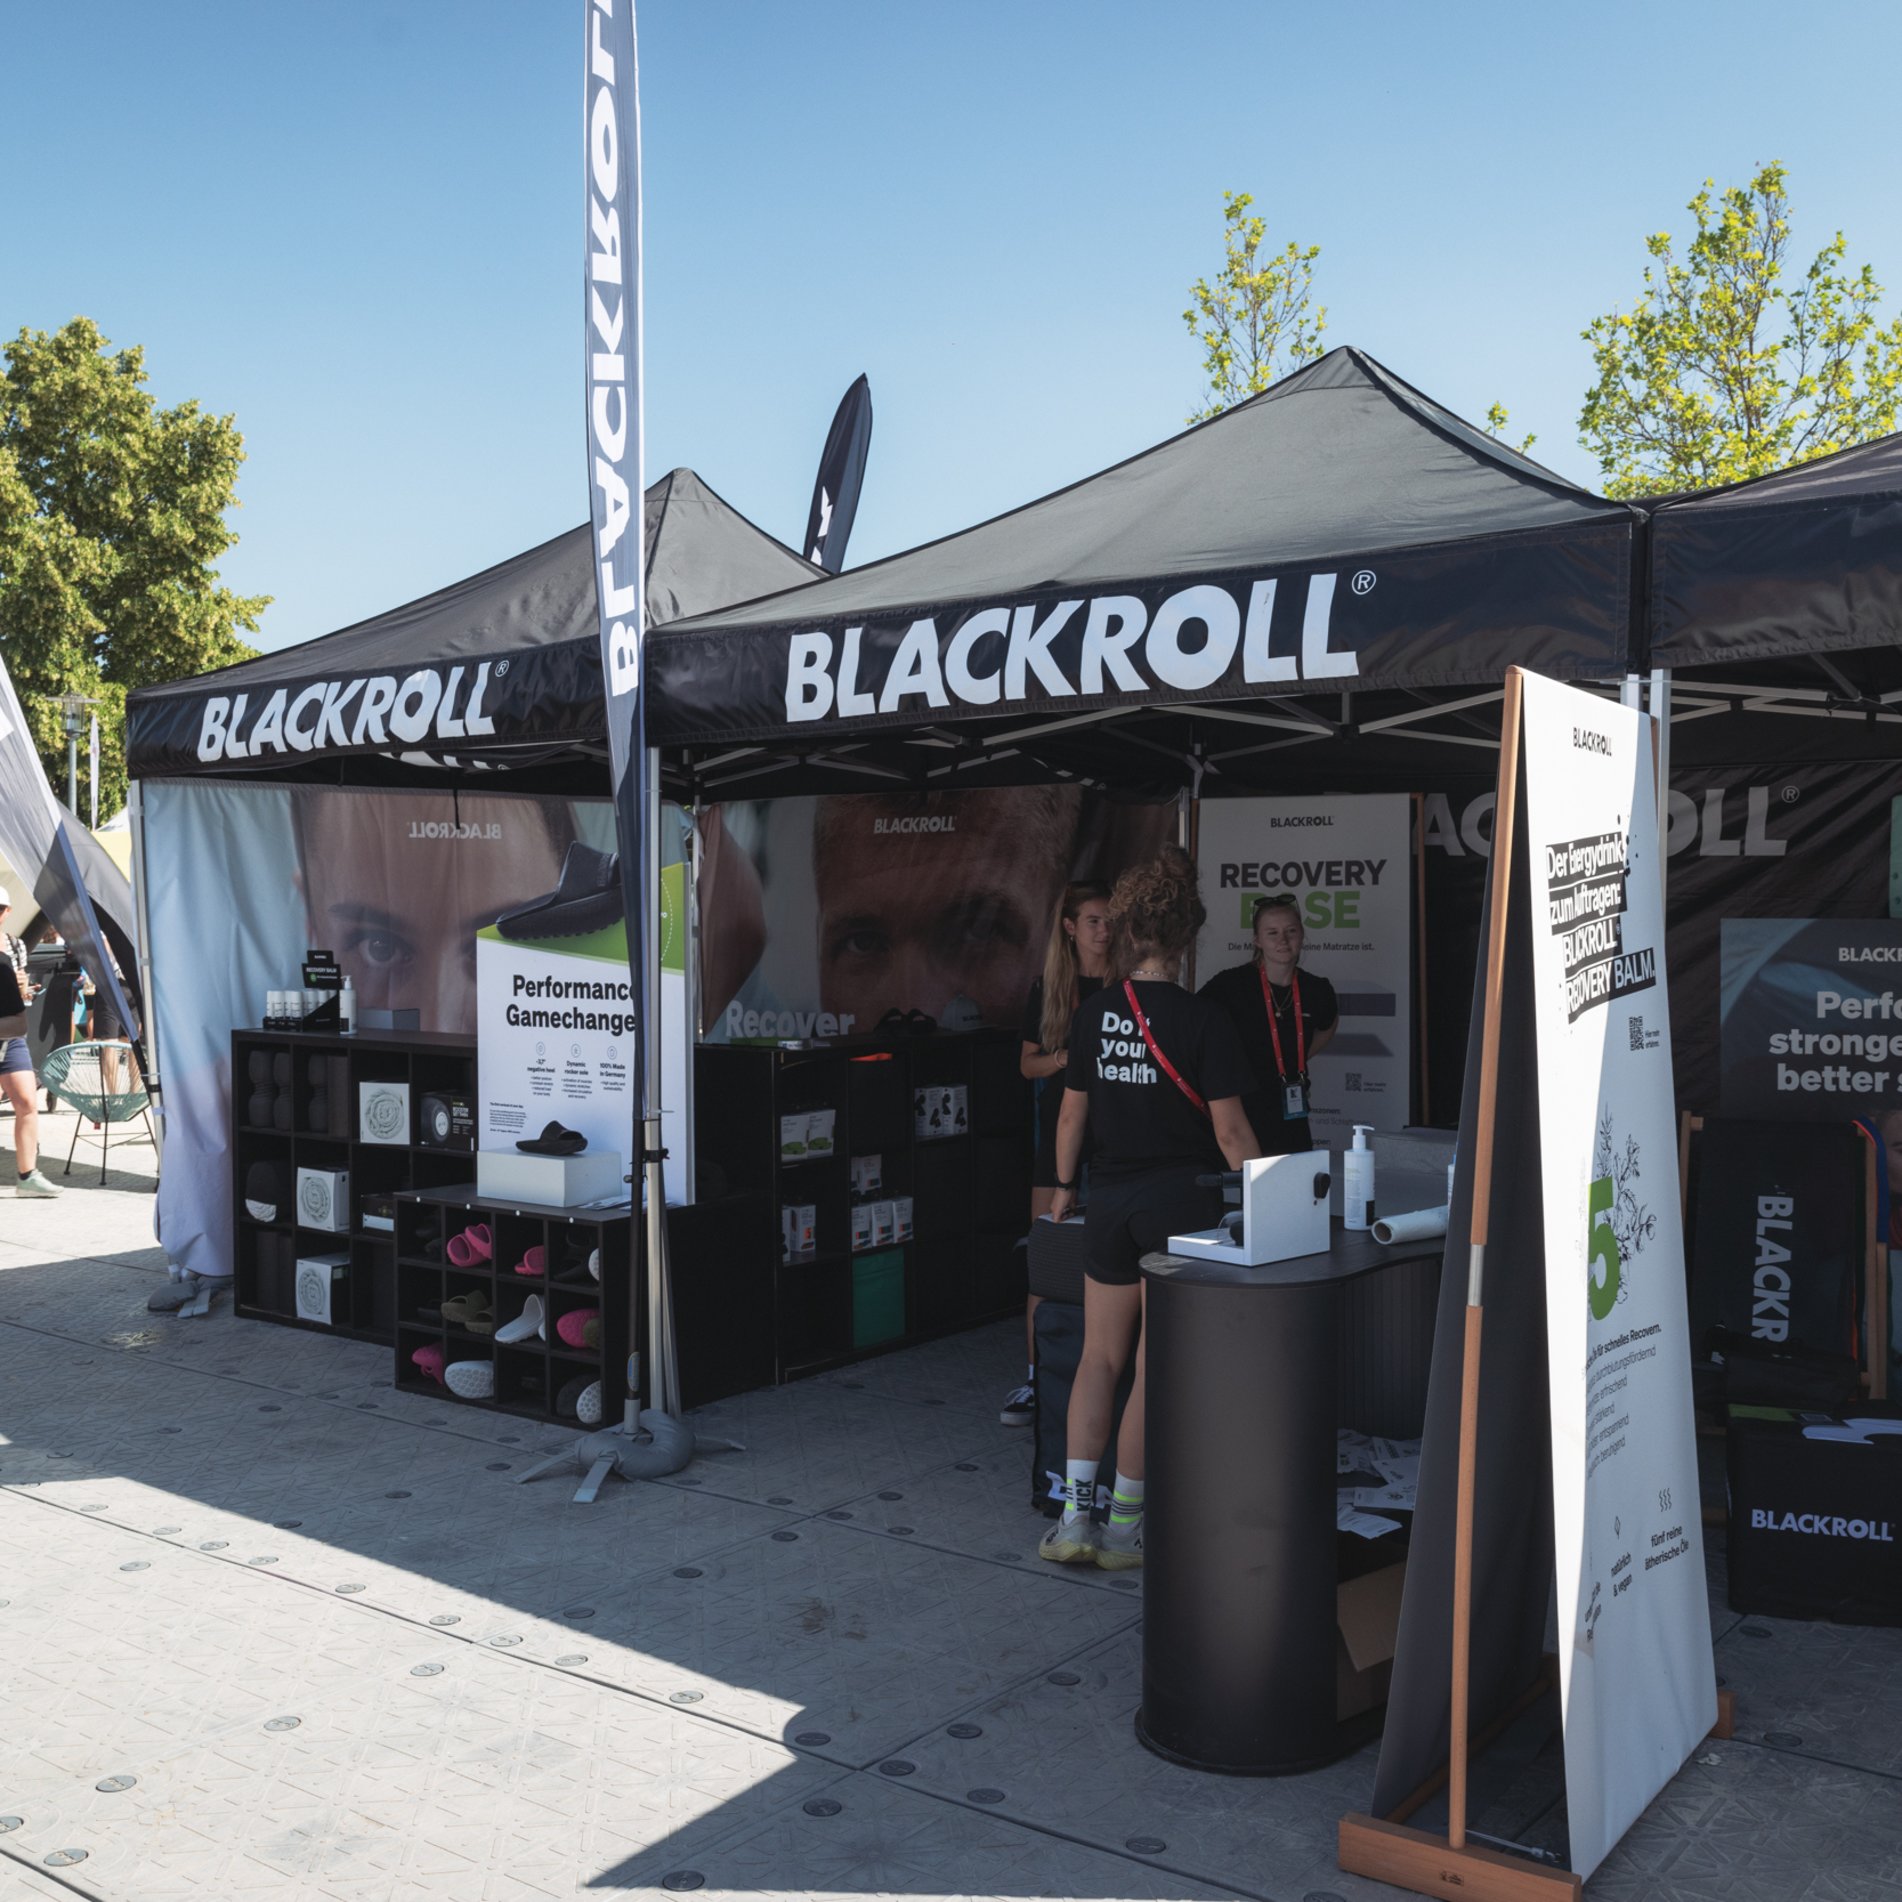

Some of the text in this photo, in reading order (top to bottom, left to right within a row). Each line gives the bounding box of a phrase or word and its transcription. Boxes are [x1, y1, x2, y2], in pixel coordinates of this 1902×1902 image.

[1220, 859, 1387, 888] RECOVERY
[1546, 846, 1568, 879] Der
[1550, 896, 1574, 924] zum
[1228, 943, 1242, 951] Die
[1323, 942, 1360, 951] Matratze
[1361, 943, 1375, 951] ist.
[1613, 950, 1655, 988] BALM.
[725, 1000, 855, 1038] Recover
[1101, 1011, 1134, 1035] Do
[1101, 1038, 1146, 1059] you
[1777, 1063, 1890, 1092] better
[1651, 1525, 1683, 1548] fünf reine
[1751, 1508, 1893, 1542] BLACKROLL
[1645, 1544, 1680, 1571] ätherische
